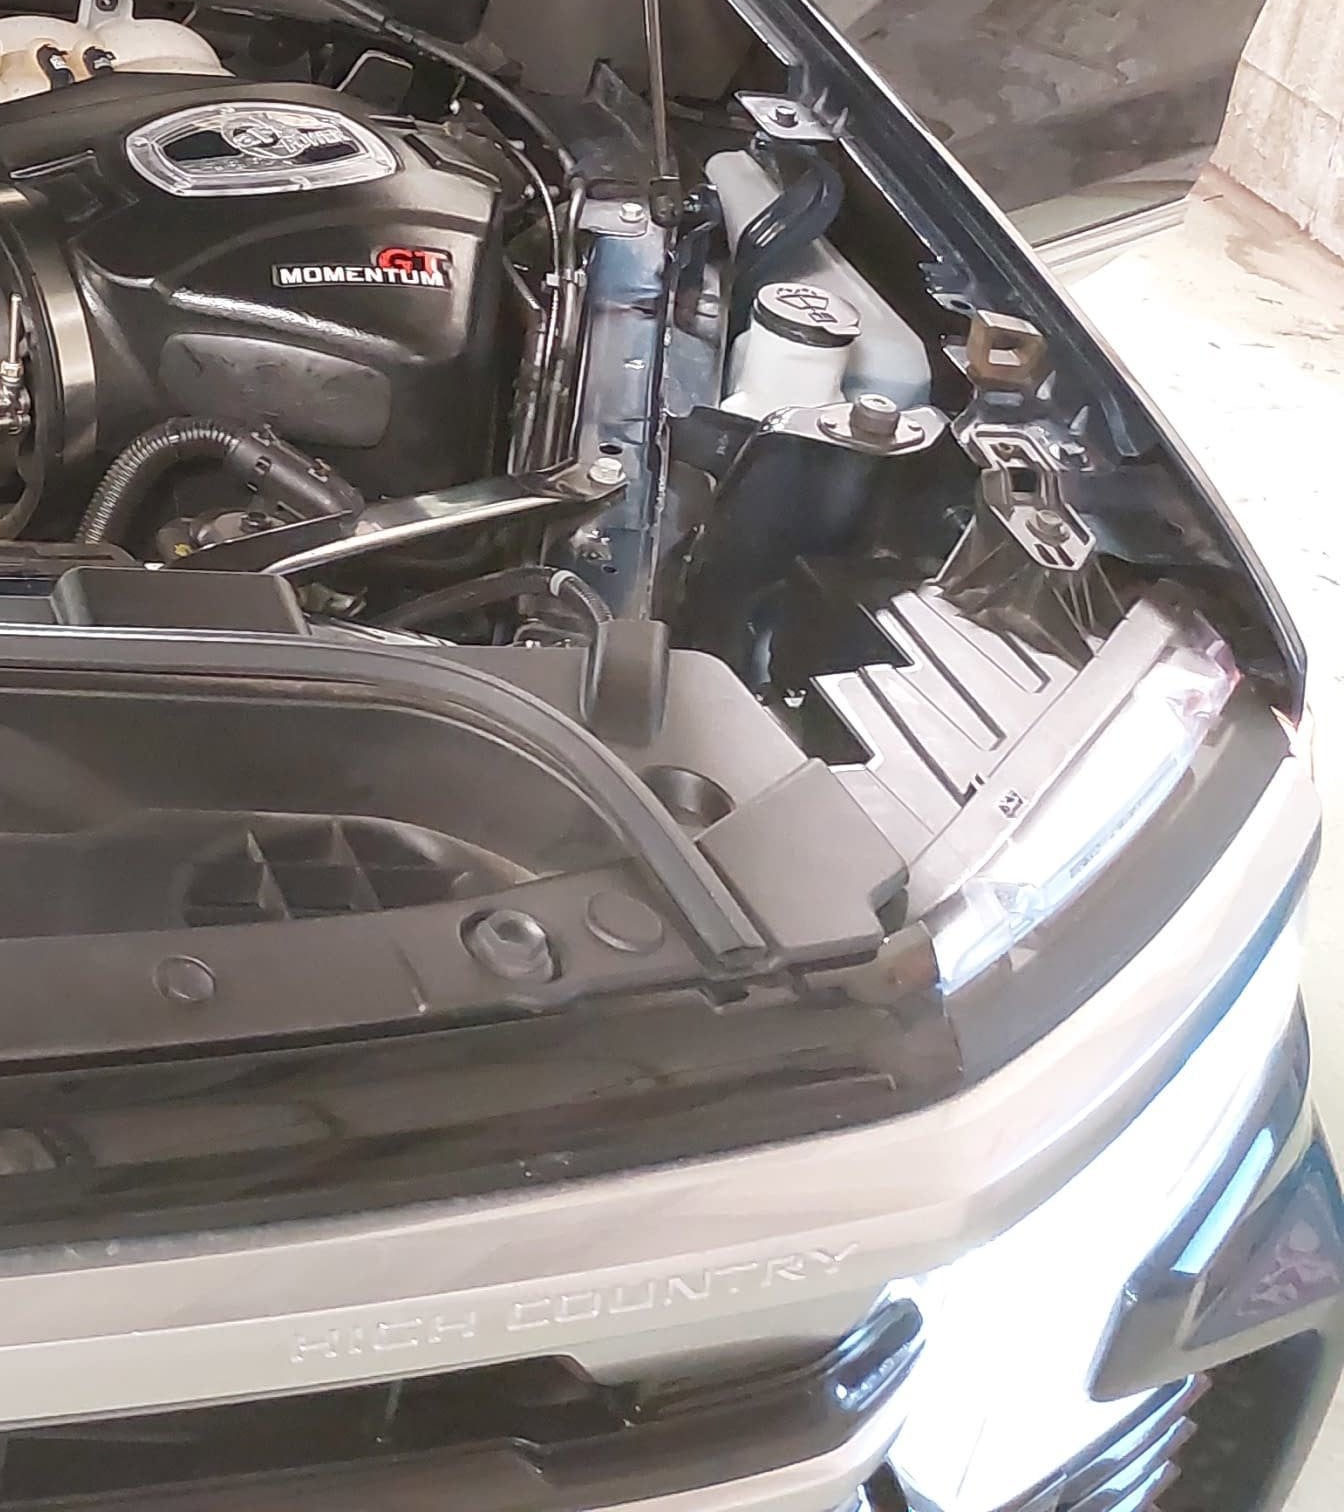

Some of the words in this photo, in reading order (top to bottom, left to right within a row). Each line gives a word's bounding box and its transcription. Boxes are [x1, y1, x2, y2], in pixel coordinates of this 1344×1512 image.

[378, 248, 447, 274] GT
[279, 266, 445, 286] MOMENTUM
[288, 1311, 478, 1364] HIGH
[506, 1243, 860, 1331] COUNTRY
